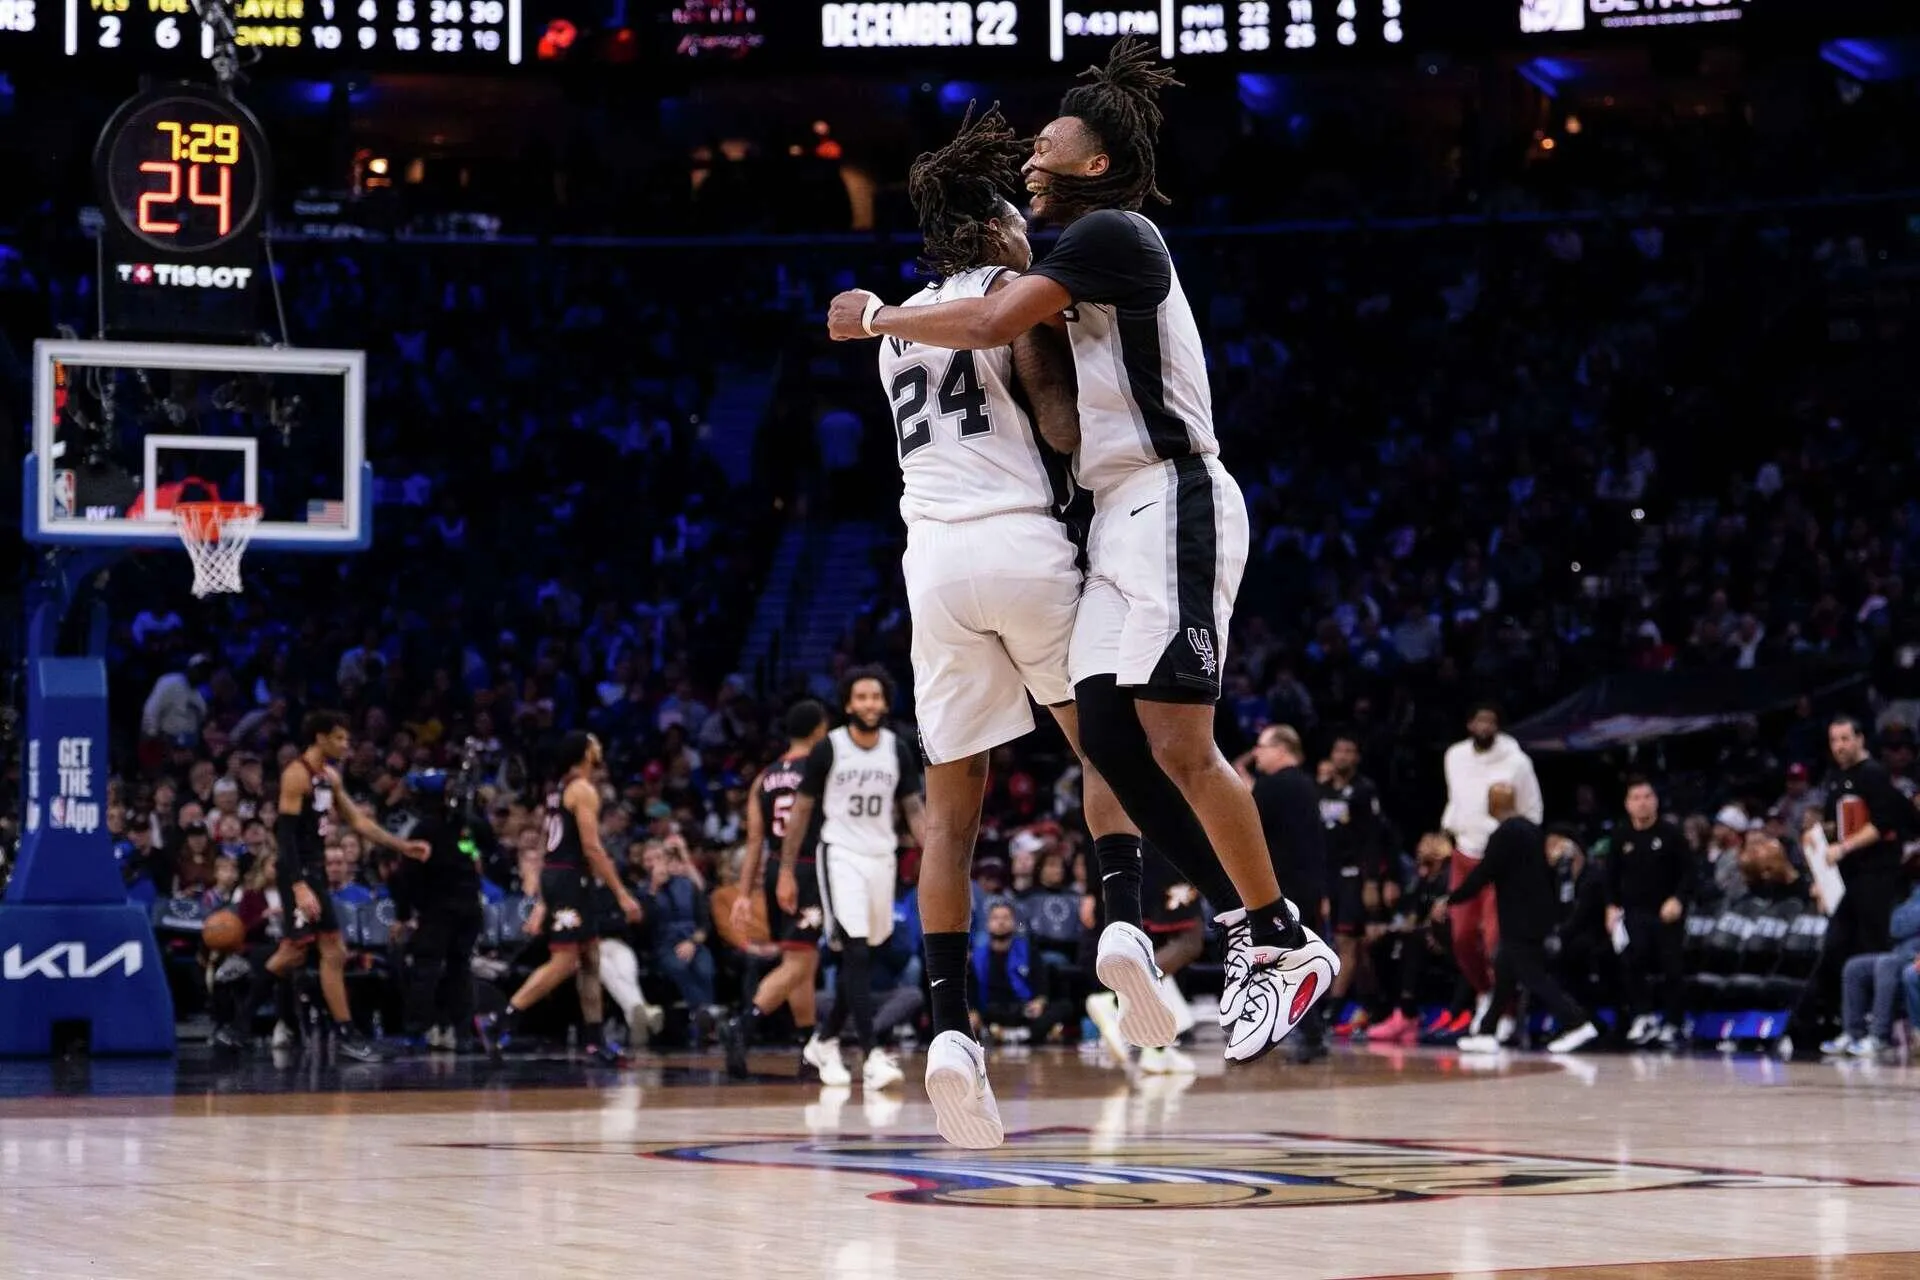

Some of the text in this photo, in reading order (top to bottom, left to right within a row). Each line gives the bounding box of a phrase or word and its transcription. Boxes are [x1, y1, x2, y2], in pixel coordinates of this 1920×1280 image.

[359, 0, 376, 20] 4
[471, 1, 503, 23] 30
[822, 1, 1017, 46] DECEMBER 22
[1065, 11, 1158, 35] 9:43 PM
[1239, 2, 1269, 26] 22
[99, 15, 180, 48] 2 6
[312, 26, 341, 48] 10
[359, 27, 376, 49] 9
[432, 29, 462, 51] 22
[473, 31, 500, 50] 10
[1181, 30, 1227, 54] SAS
[156, 121, 239, 164] 7:29
[138, 161, 232, 236] 24
[153, 264, 252, 289] TISSOT
[890, 349, 995, 460] 24
[57, 736, 94, 768] GET
[57, 768, 94, 797] THE
[836, 768, 896, 787] SPURS
[65, 797, 100, 834] App
[772, 794, 796, 838] 5
[850, 794, 883, 817] 30
[4, 941, 143, 980] KIA
